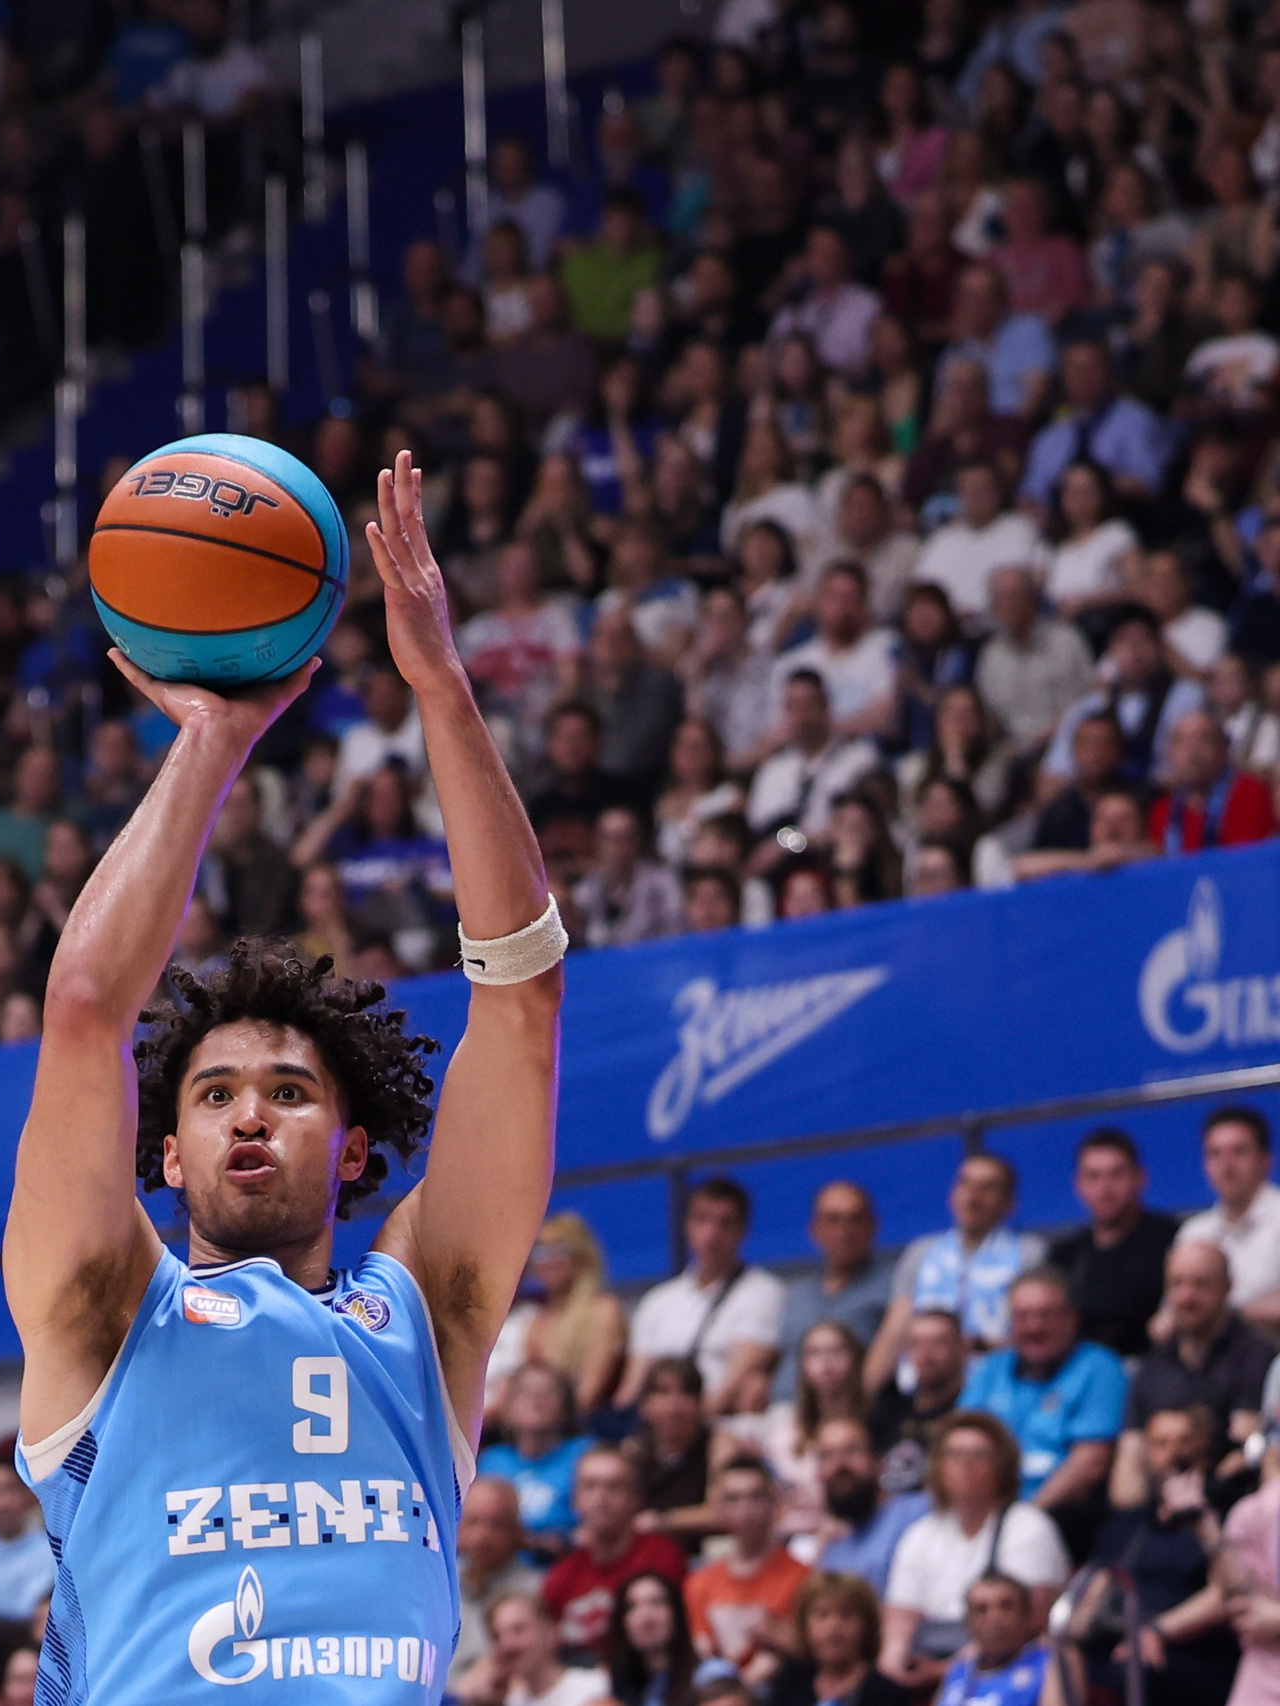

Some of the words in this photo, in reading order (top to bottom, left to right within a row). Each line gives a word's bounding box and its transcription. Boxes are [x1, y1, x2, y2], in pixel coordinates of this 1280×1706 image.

[128, 471, 280, 518] JÖGEL
[197, 1298, 236, 1313] WIN
[292, 1355, 349, 1454] 9
